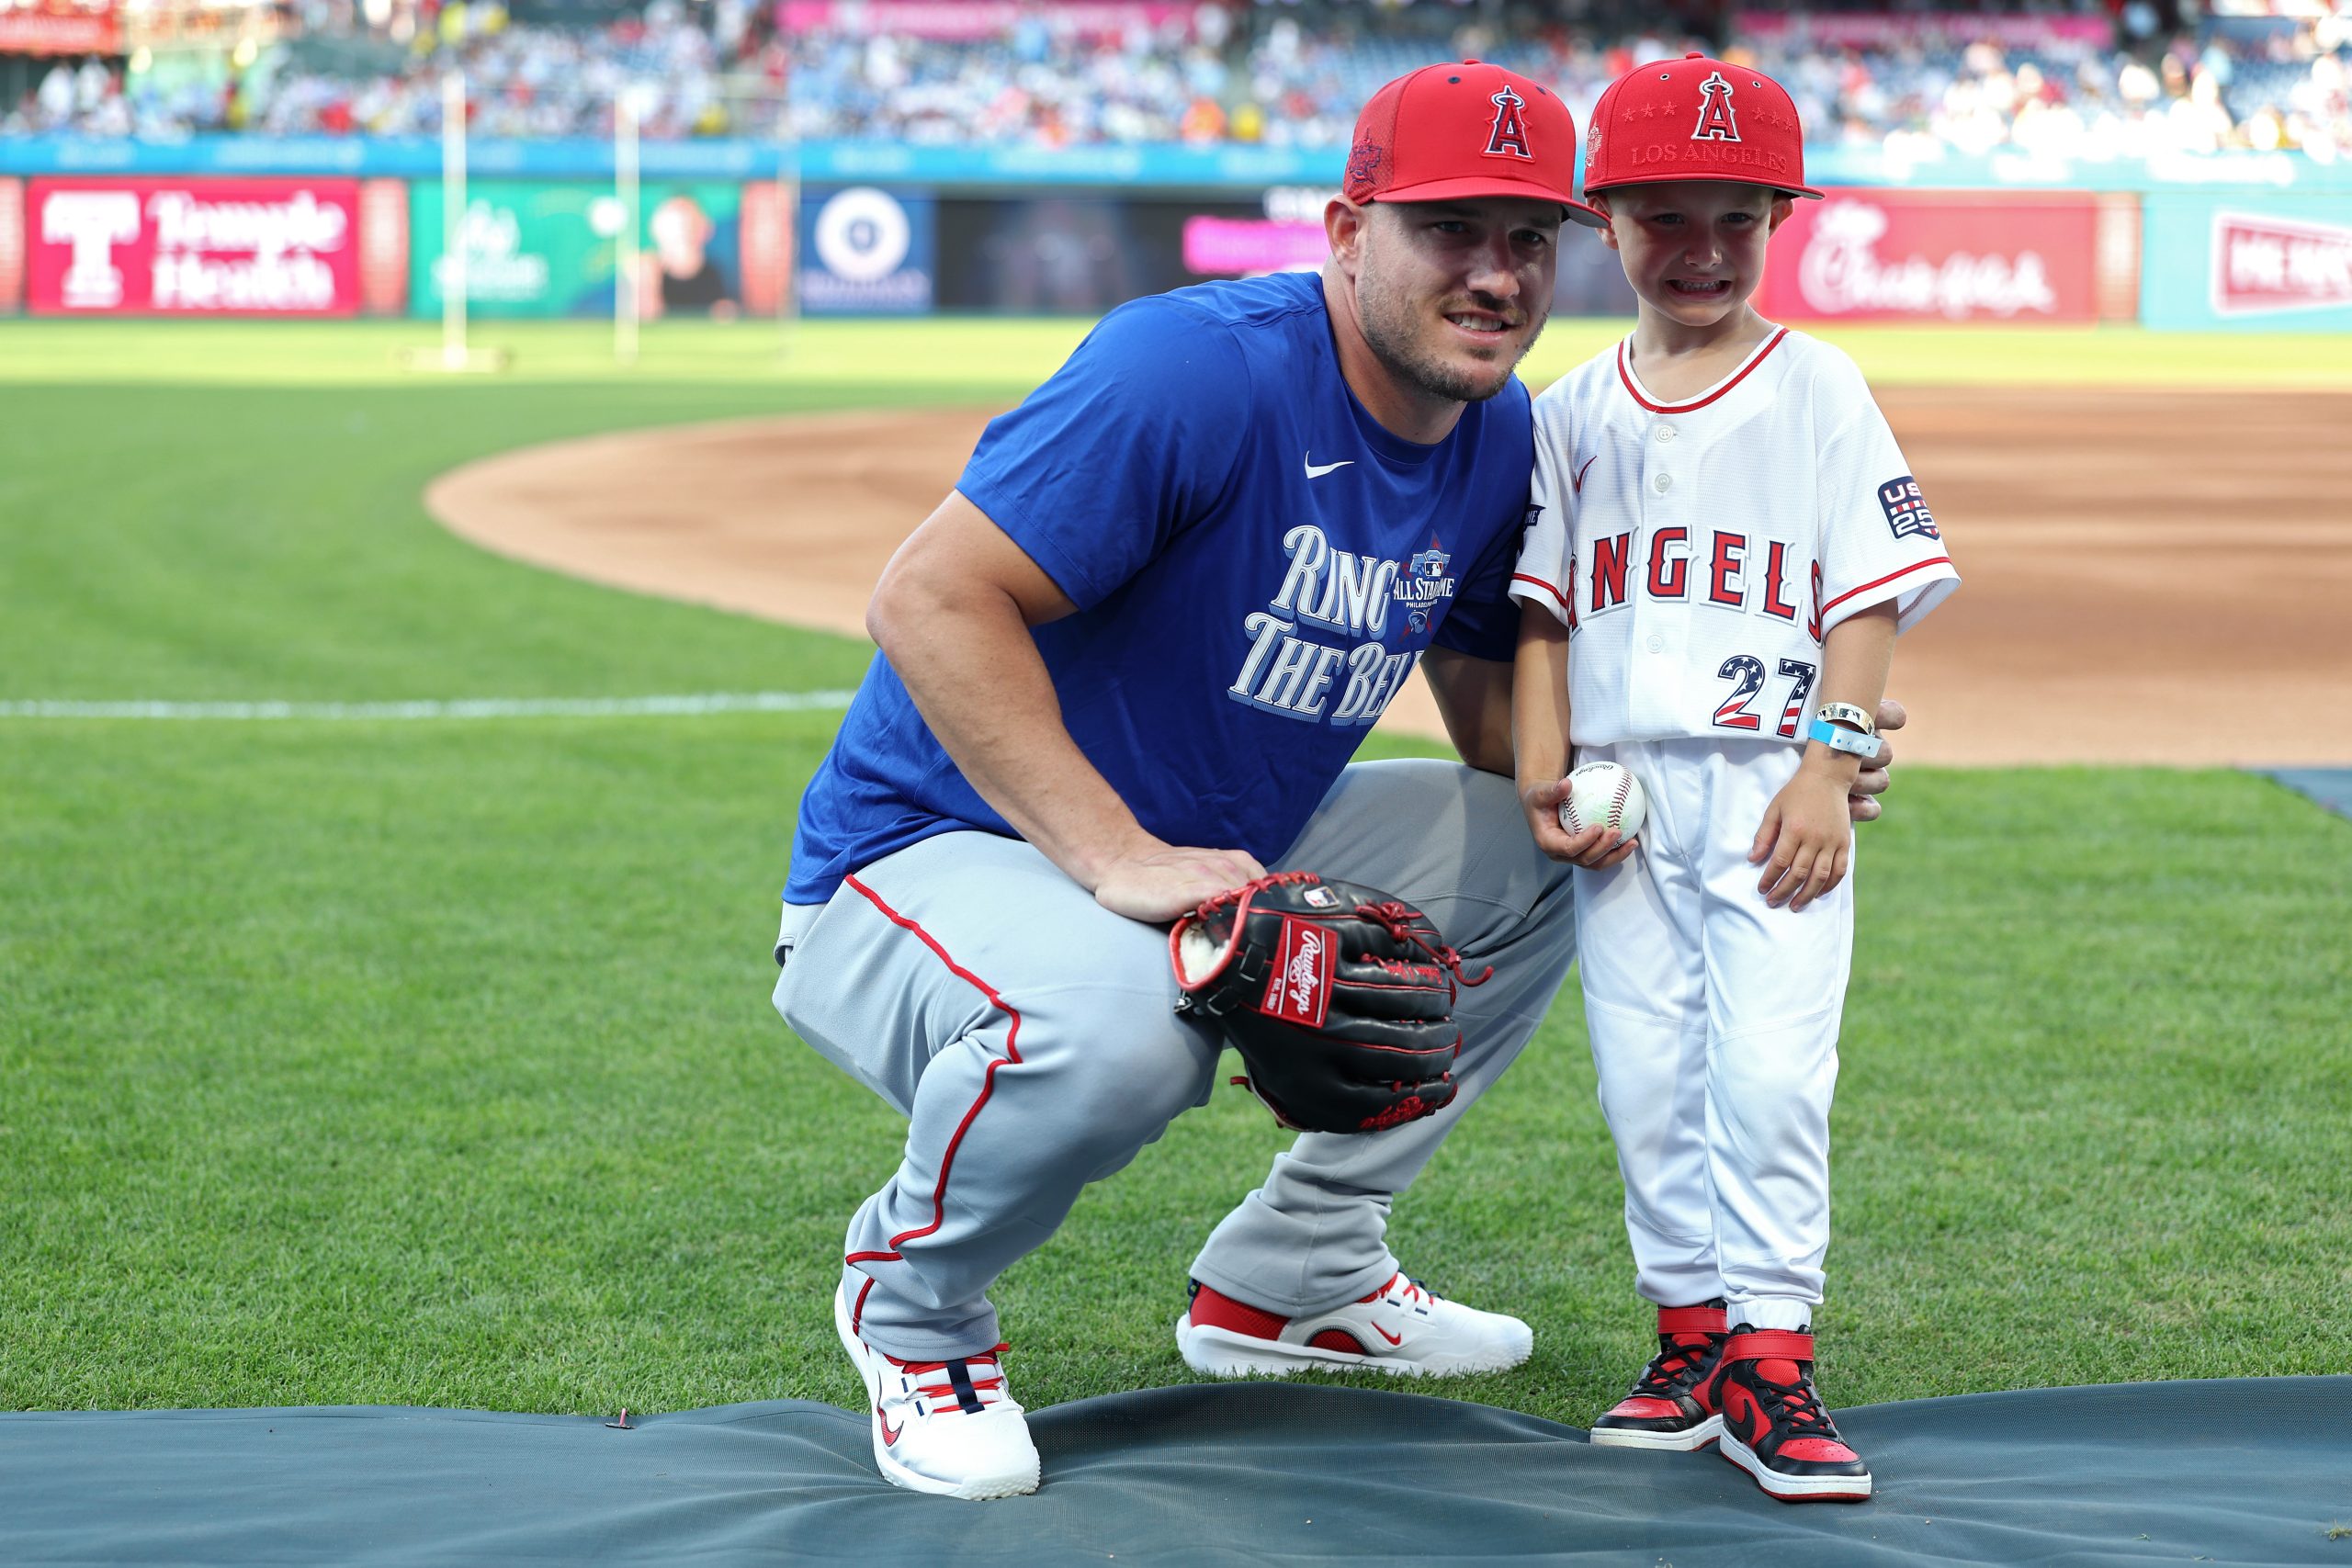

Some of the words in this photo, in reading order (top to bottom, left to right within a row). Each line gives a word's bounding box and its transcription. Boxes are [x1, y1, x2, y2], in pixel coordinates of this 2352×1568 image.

[1483, 84, 1533, 160] A
[1690, 72, 1741, 141] A
[1631, 144, 1677, 166] LOS
[1681, 142, 1787, 175] ANGELES
[1270, 525, 1399, 638] RING
[1394, 578, 1415, 601] ALL
[1227, 612, 1347, 723] THE
[1712, 654, 1816, 739] 27
[1289, 930, 1321, 1015] Rawlings
